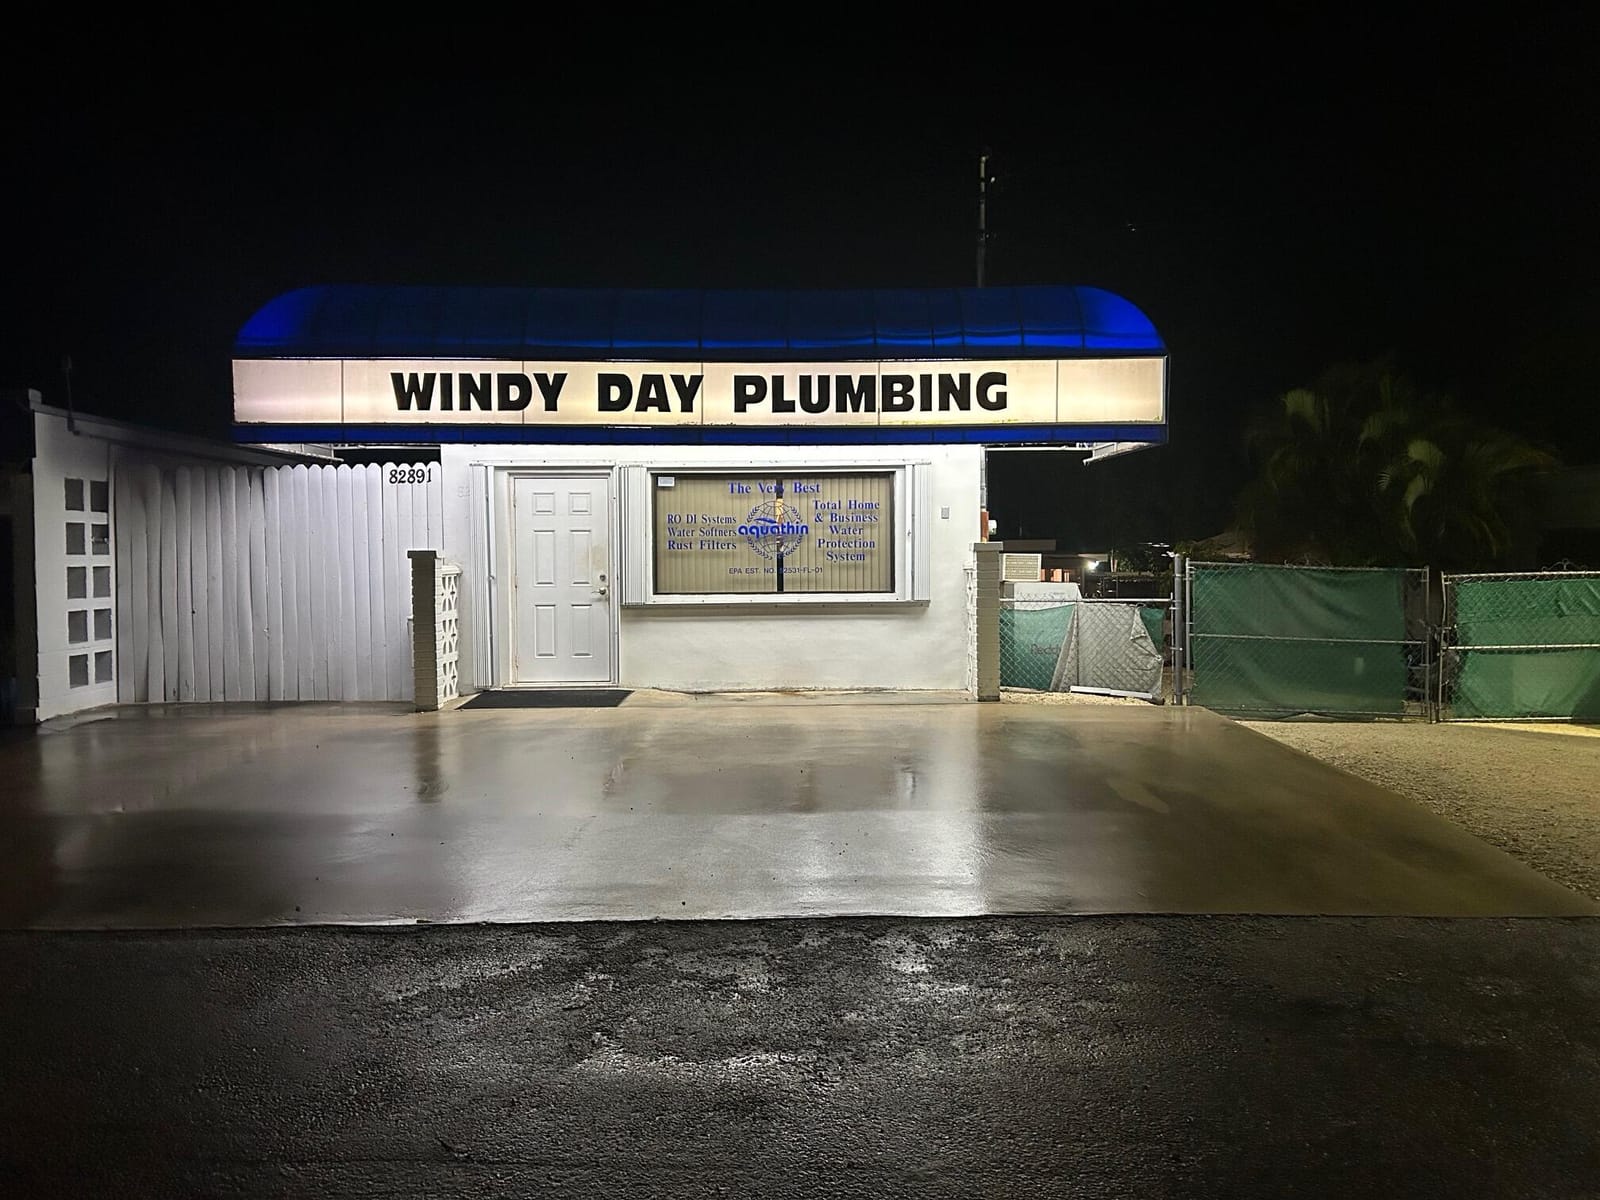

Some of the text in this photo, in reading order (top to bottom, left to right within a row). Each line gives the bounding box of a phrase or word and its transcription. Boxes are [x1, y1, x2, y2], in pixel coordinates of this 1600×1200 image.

[391, 372, 1008, 413] WINDY DAY PLUMBING
[389, 468, 431, 484] 82891
[728, 482, 751, 494] The
[794, 482, 820, 494] Best
[812, 500, 880, 510] Total Home
[667, 514, 737, 526] RO DI Systems
[814, 513, 878, 523] & Business
[667, 527, 737, 537] Water Softners
[738, 522, 808, 539] aquathin
[829, 525, 863, 535] Water
[668, 540, 737, 550] Rust Filters
[818, 539, 875, 549] Protection
[826, 551, 865, 562] System
